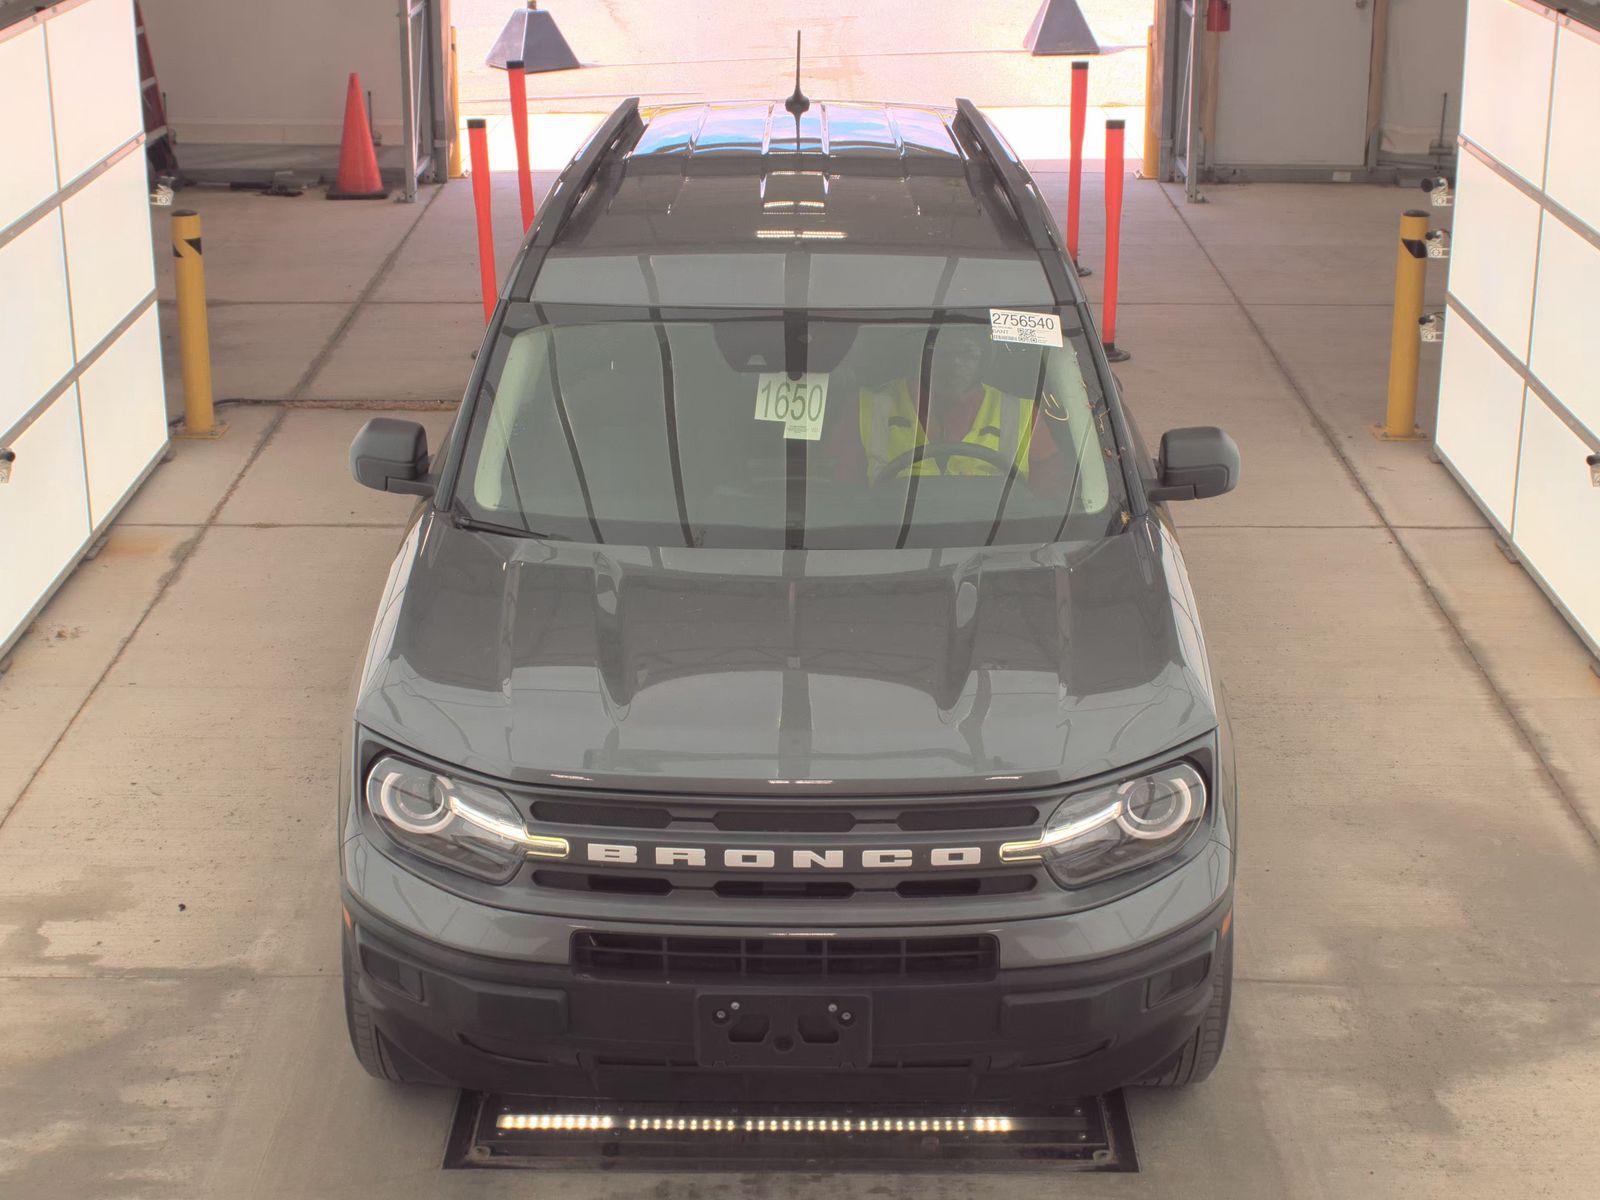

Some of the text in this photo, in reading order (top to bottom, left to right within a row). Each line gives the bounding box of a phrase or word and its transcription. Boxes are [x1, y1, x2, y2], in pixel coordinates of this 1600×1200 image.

[992, 313, 1054, 330] 2756540
[761, 380, 823, 421] 1650
[587, 843, 982, 868] BRONCO
